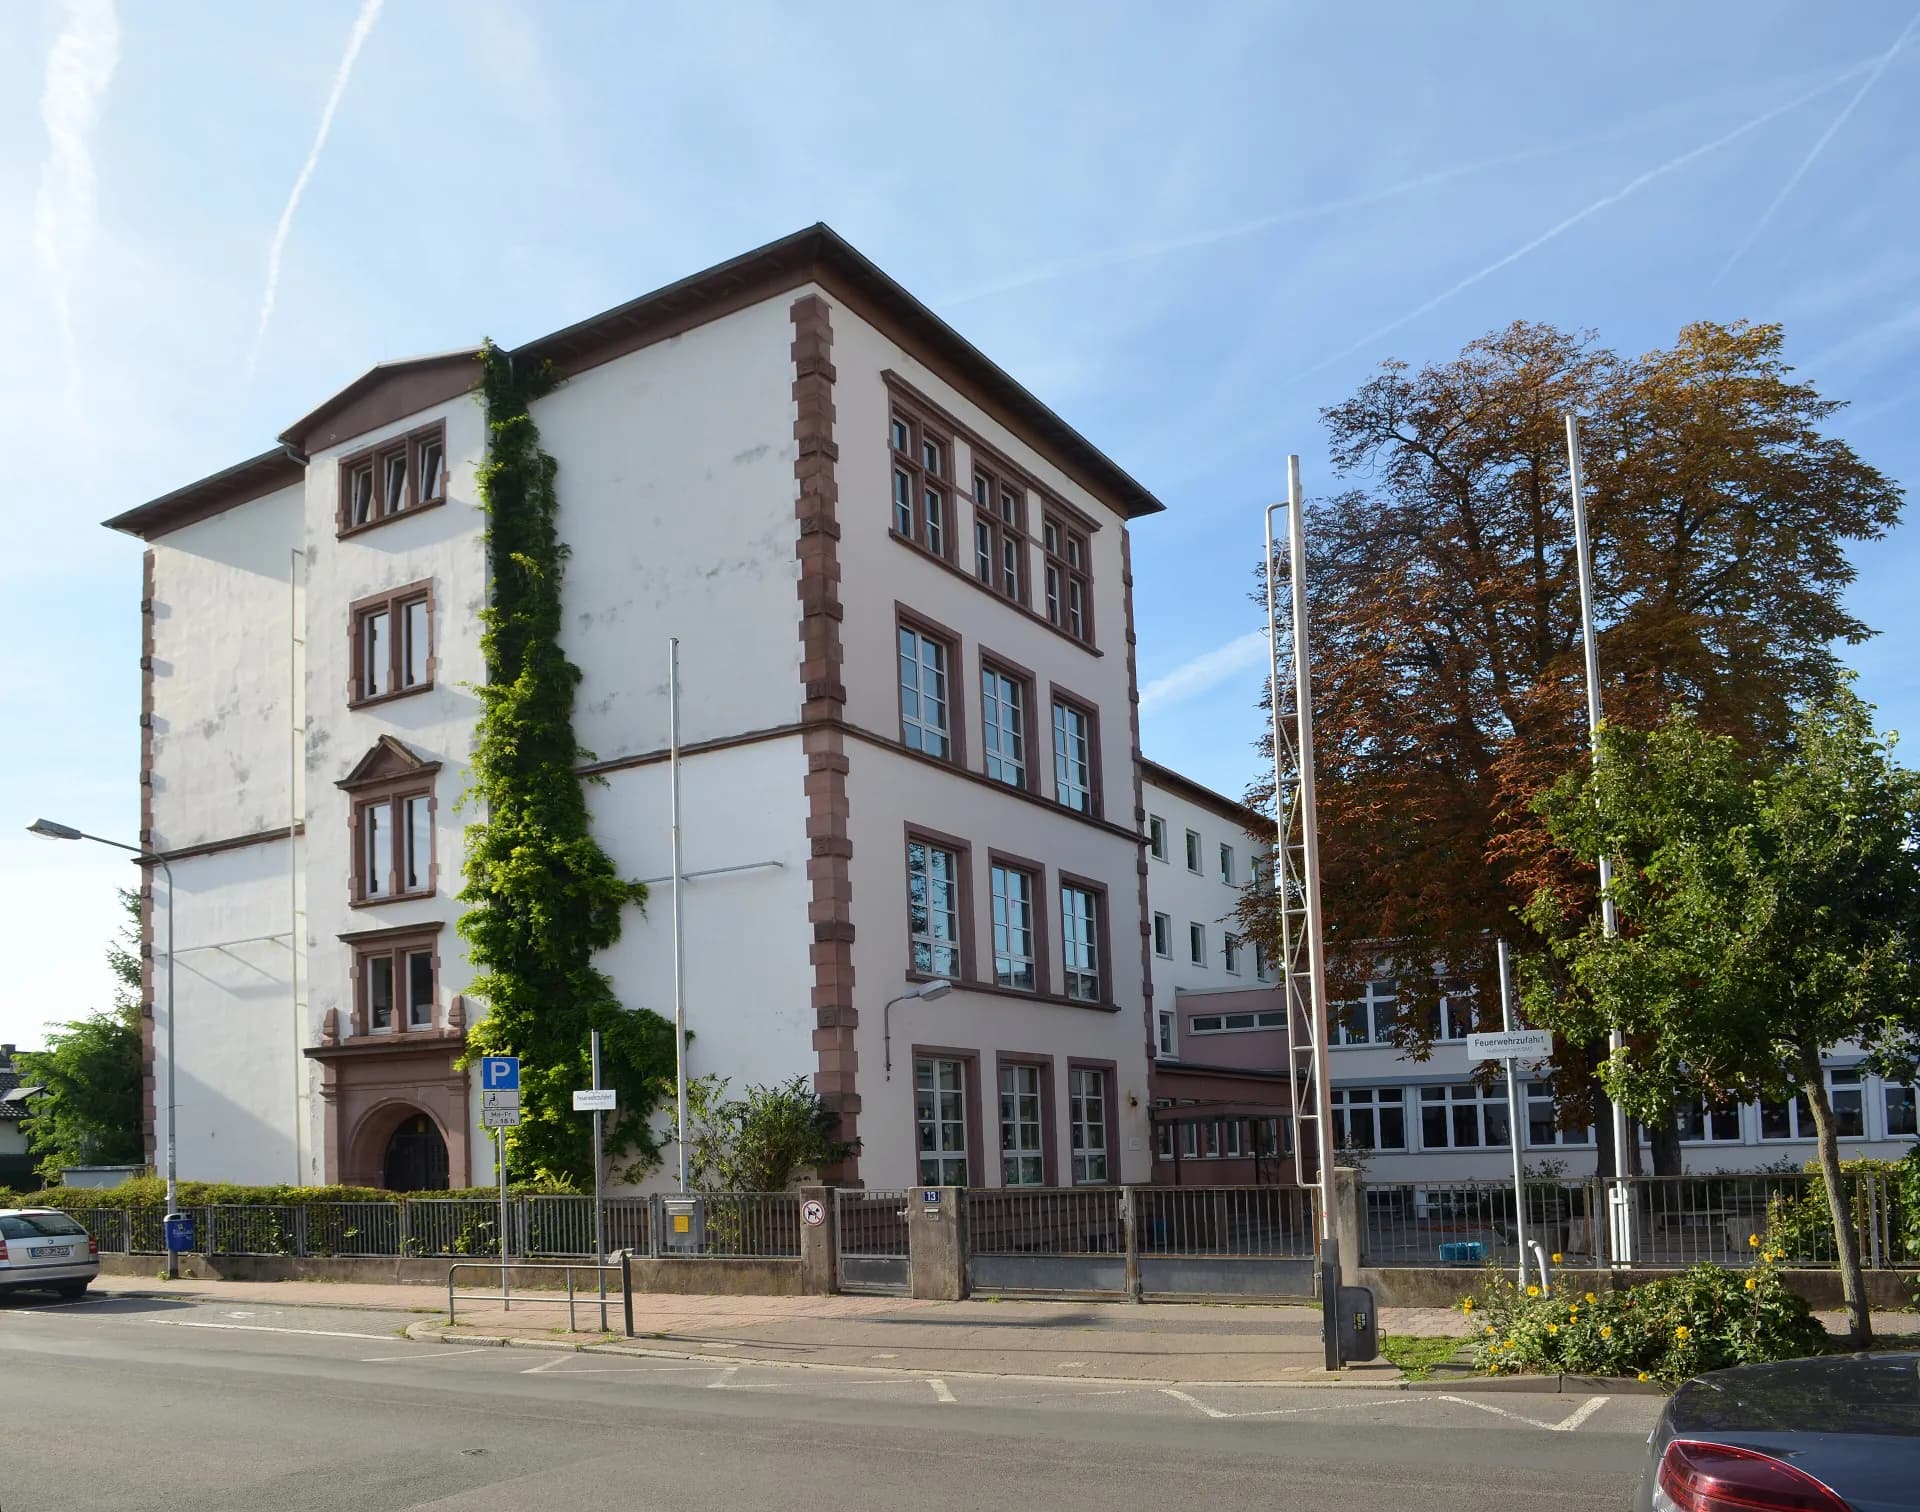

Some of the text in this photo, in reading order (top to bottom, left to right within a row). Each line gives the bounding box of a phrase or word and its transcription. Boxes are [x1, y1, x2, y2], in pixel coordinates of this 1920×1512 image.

[1474, 1036, 1544, 1047] Feuerwehrzufahrt
[491, 1061, 510, 1086] P
[927, 1191, 936, 1201] 13
